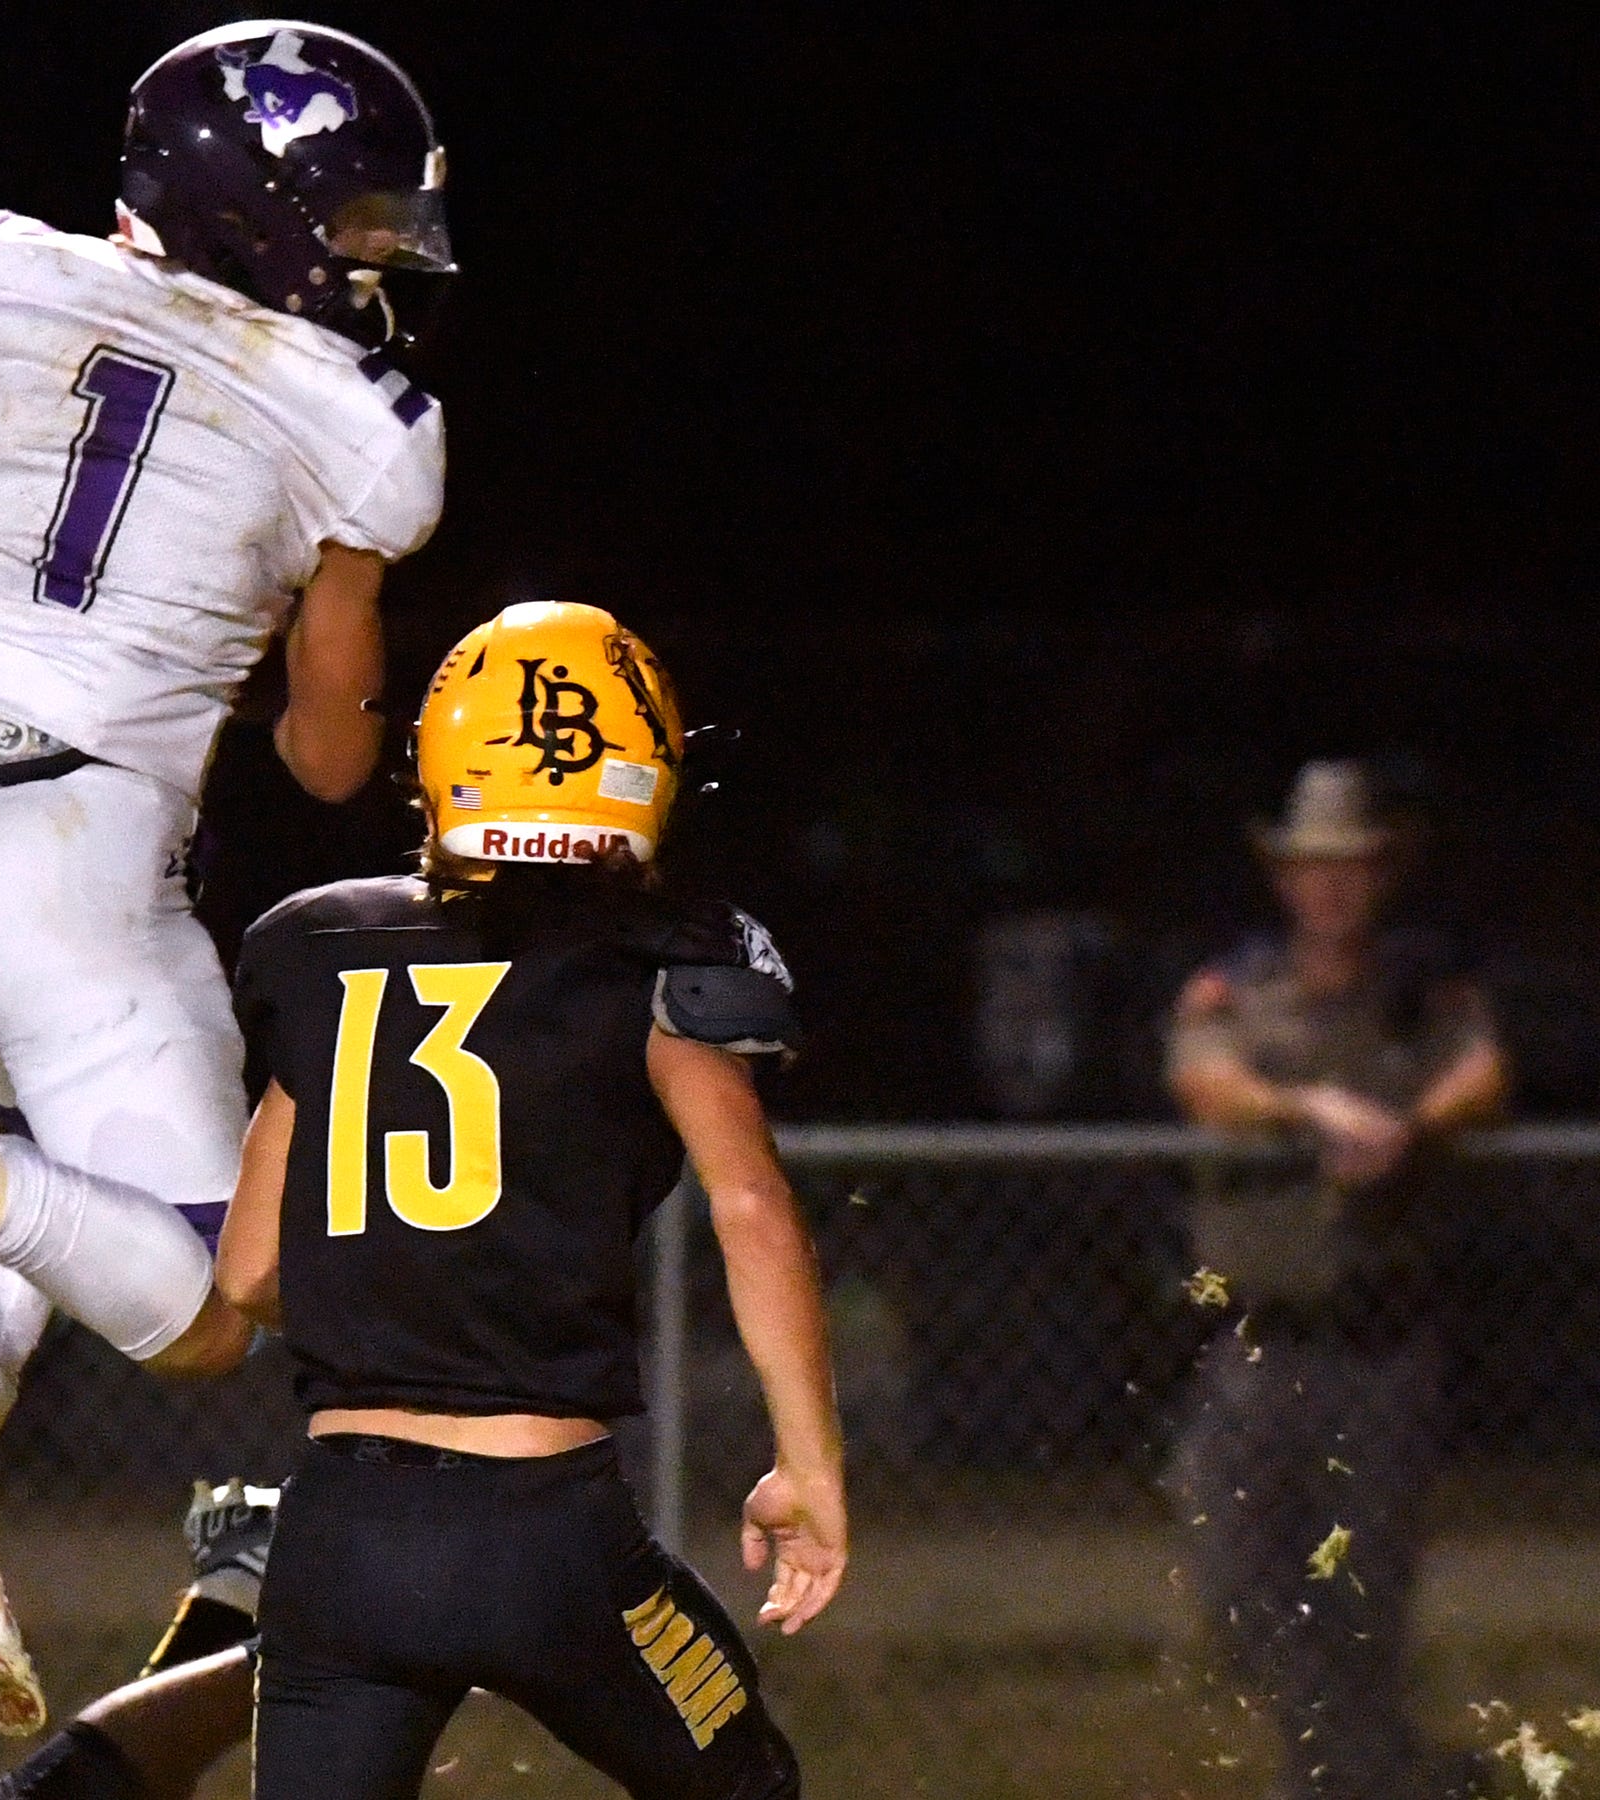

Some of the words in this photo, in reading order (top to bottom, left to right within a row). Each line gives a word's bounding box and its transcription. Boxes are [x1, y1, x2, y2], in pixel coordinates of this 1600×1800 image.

[33, 343, 176, 614] 1
[512, 658, 605, 786] LB
[327, 961, 512, 1237] 13
